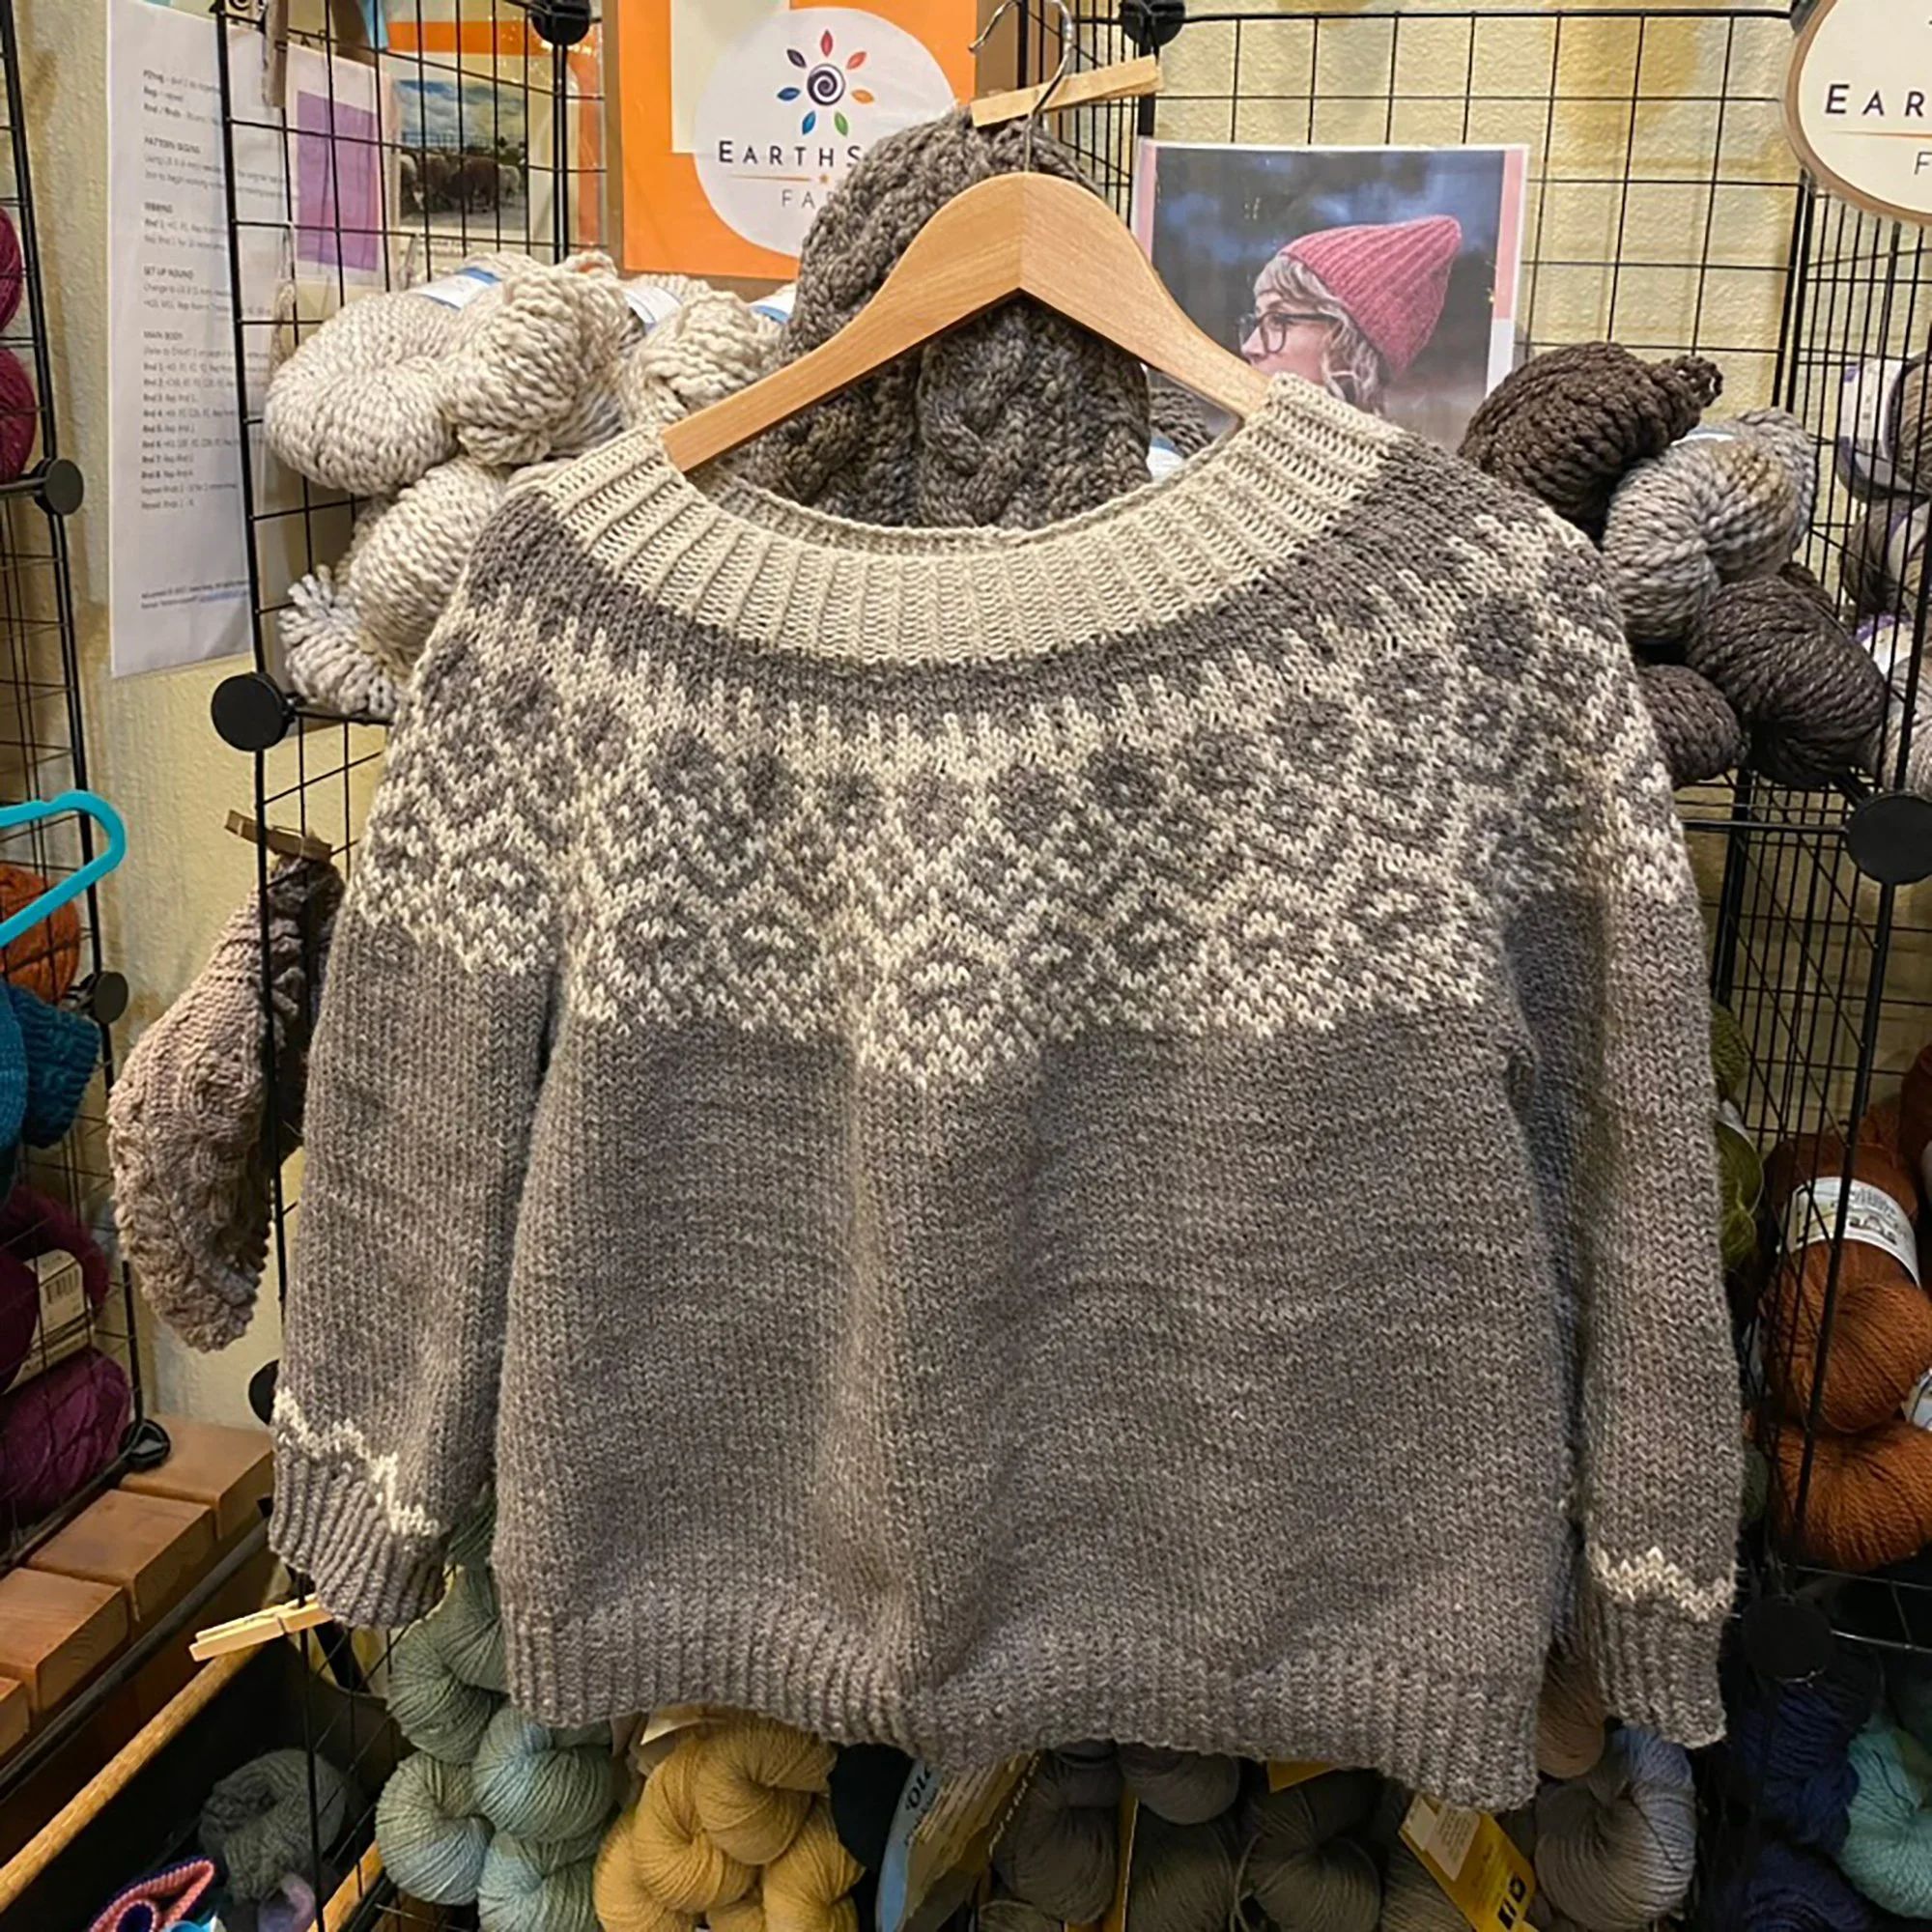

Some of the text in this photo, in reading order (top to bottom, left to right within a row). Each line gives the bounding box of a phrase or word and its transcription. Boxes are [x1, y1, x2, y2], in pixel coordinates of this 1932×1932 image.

[1825, 84, 1924, 118] EAR
[719, 140, 862, 168] EARTHS
[781, 188, 835, 210] FA
